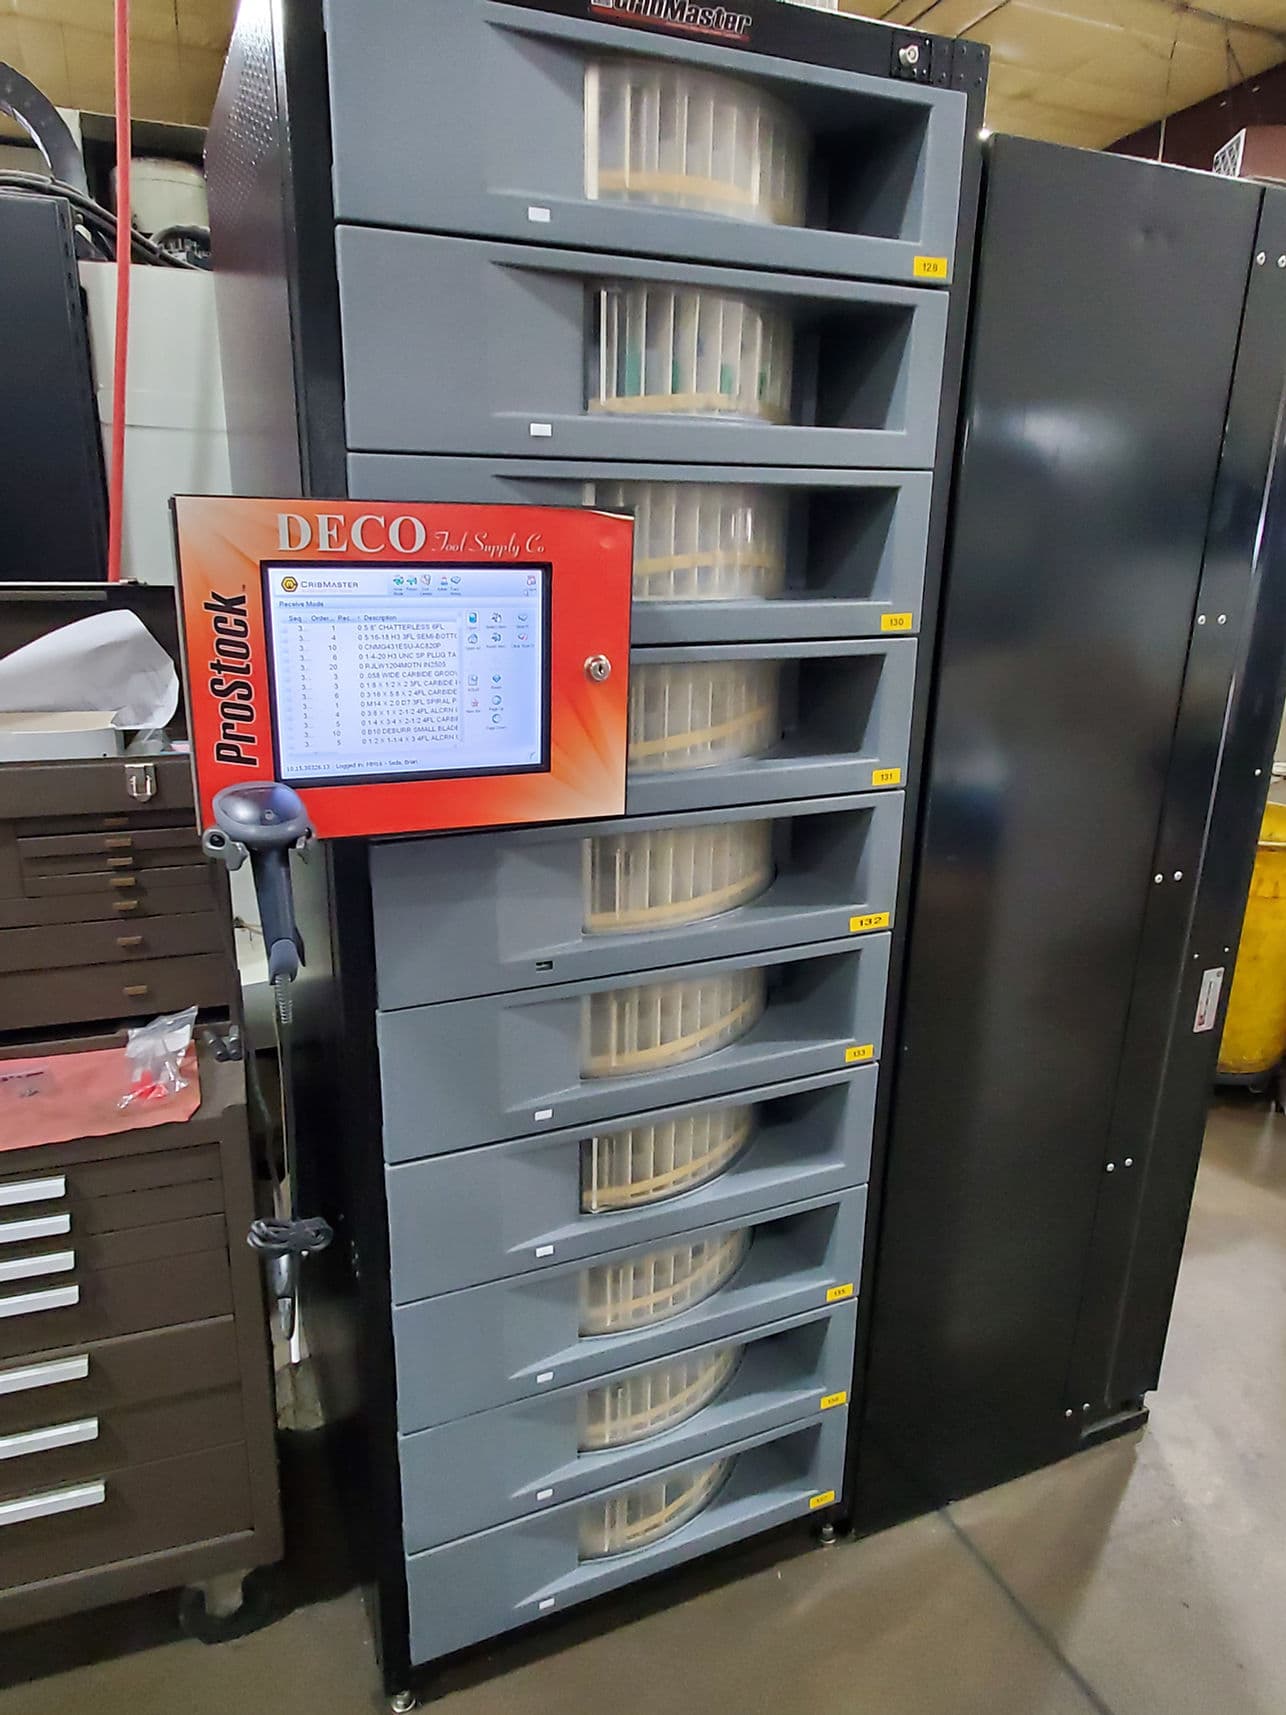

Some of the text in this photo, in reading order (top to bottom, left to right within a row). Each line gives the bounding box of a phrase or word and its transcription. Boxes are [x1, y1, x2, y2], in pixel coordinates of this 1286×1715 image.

[277, 513, 427, 553] DECO
[432, 531, 467, 552] Tool
[469, 531, 521, 557] Supply
[279, 600, 324, 608] Receive Mode
[363, 614, 398, 622] Description
[890, 617, 904, 626] 130
[378, 623, 431, 631] CHATTERLESS
[402, 670, 432, 678] CARBIDE
[203, 590, 259, 767] ProStock
[424, 679, 453, 687] CARBIDE
[413, 725, 436, 733] SMALL
[880, 773, 893, 781] 131
[859, 916, 882, 926] 132
